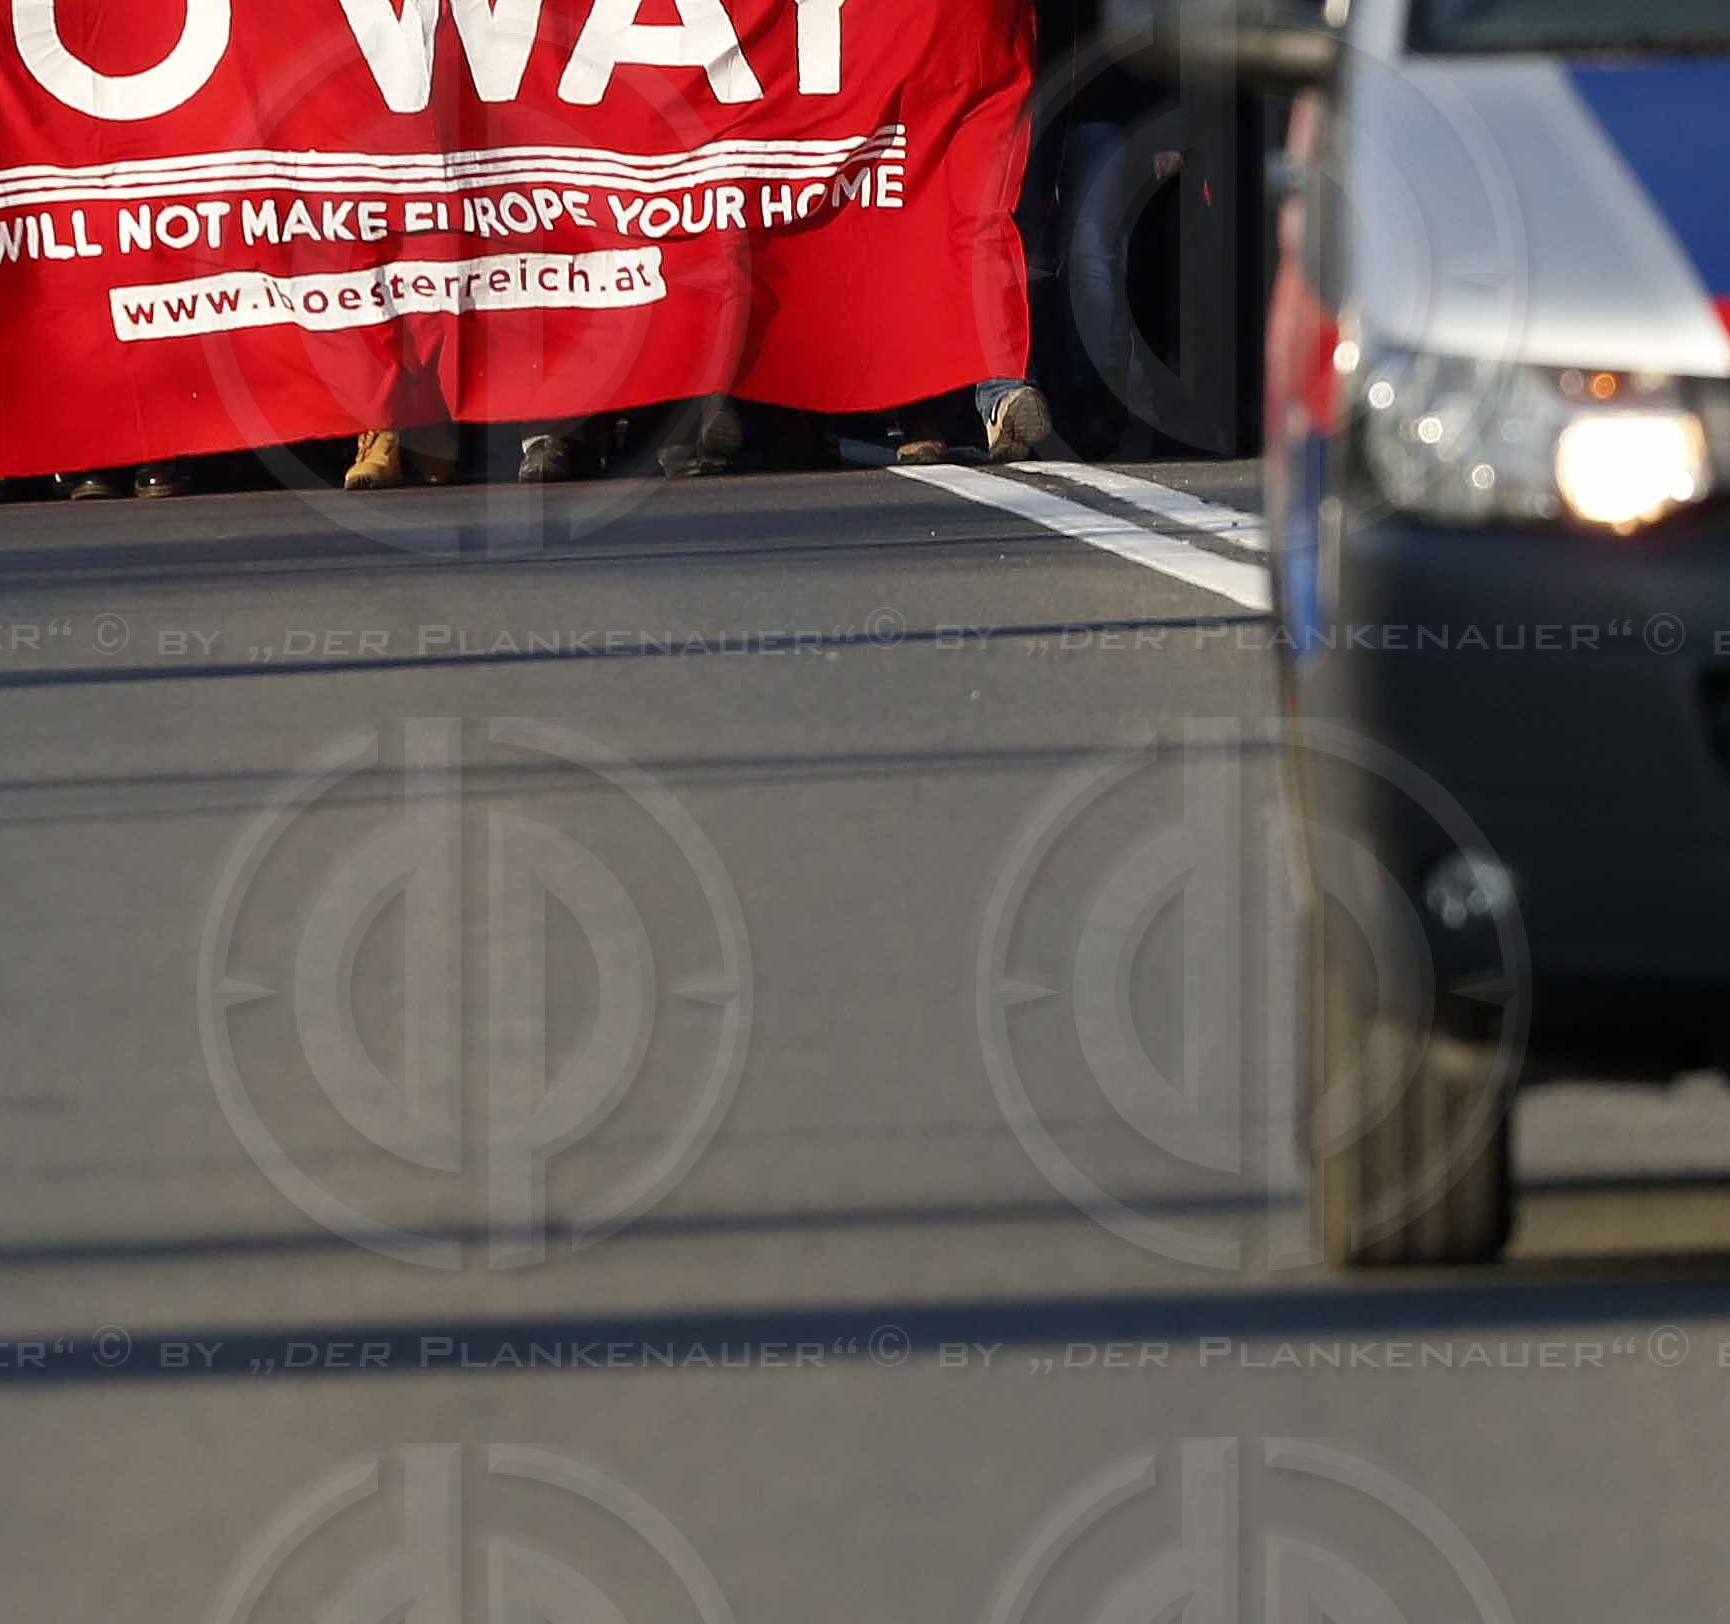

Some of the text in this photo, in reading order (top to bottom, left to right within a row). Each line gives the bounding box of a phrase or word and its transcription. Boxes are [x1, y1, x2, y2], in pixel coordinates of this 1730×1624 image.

[118, 200, 231, 254] NOT
[241, 199, 388, 246] MAKE
[404, 190, 598, 238] EUROPE
[606, 184, 747, 238] YOUR
[760, 165, 905, 228] HOME
